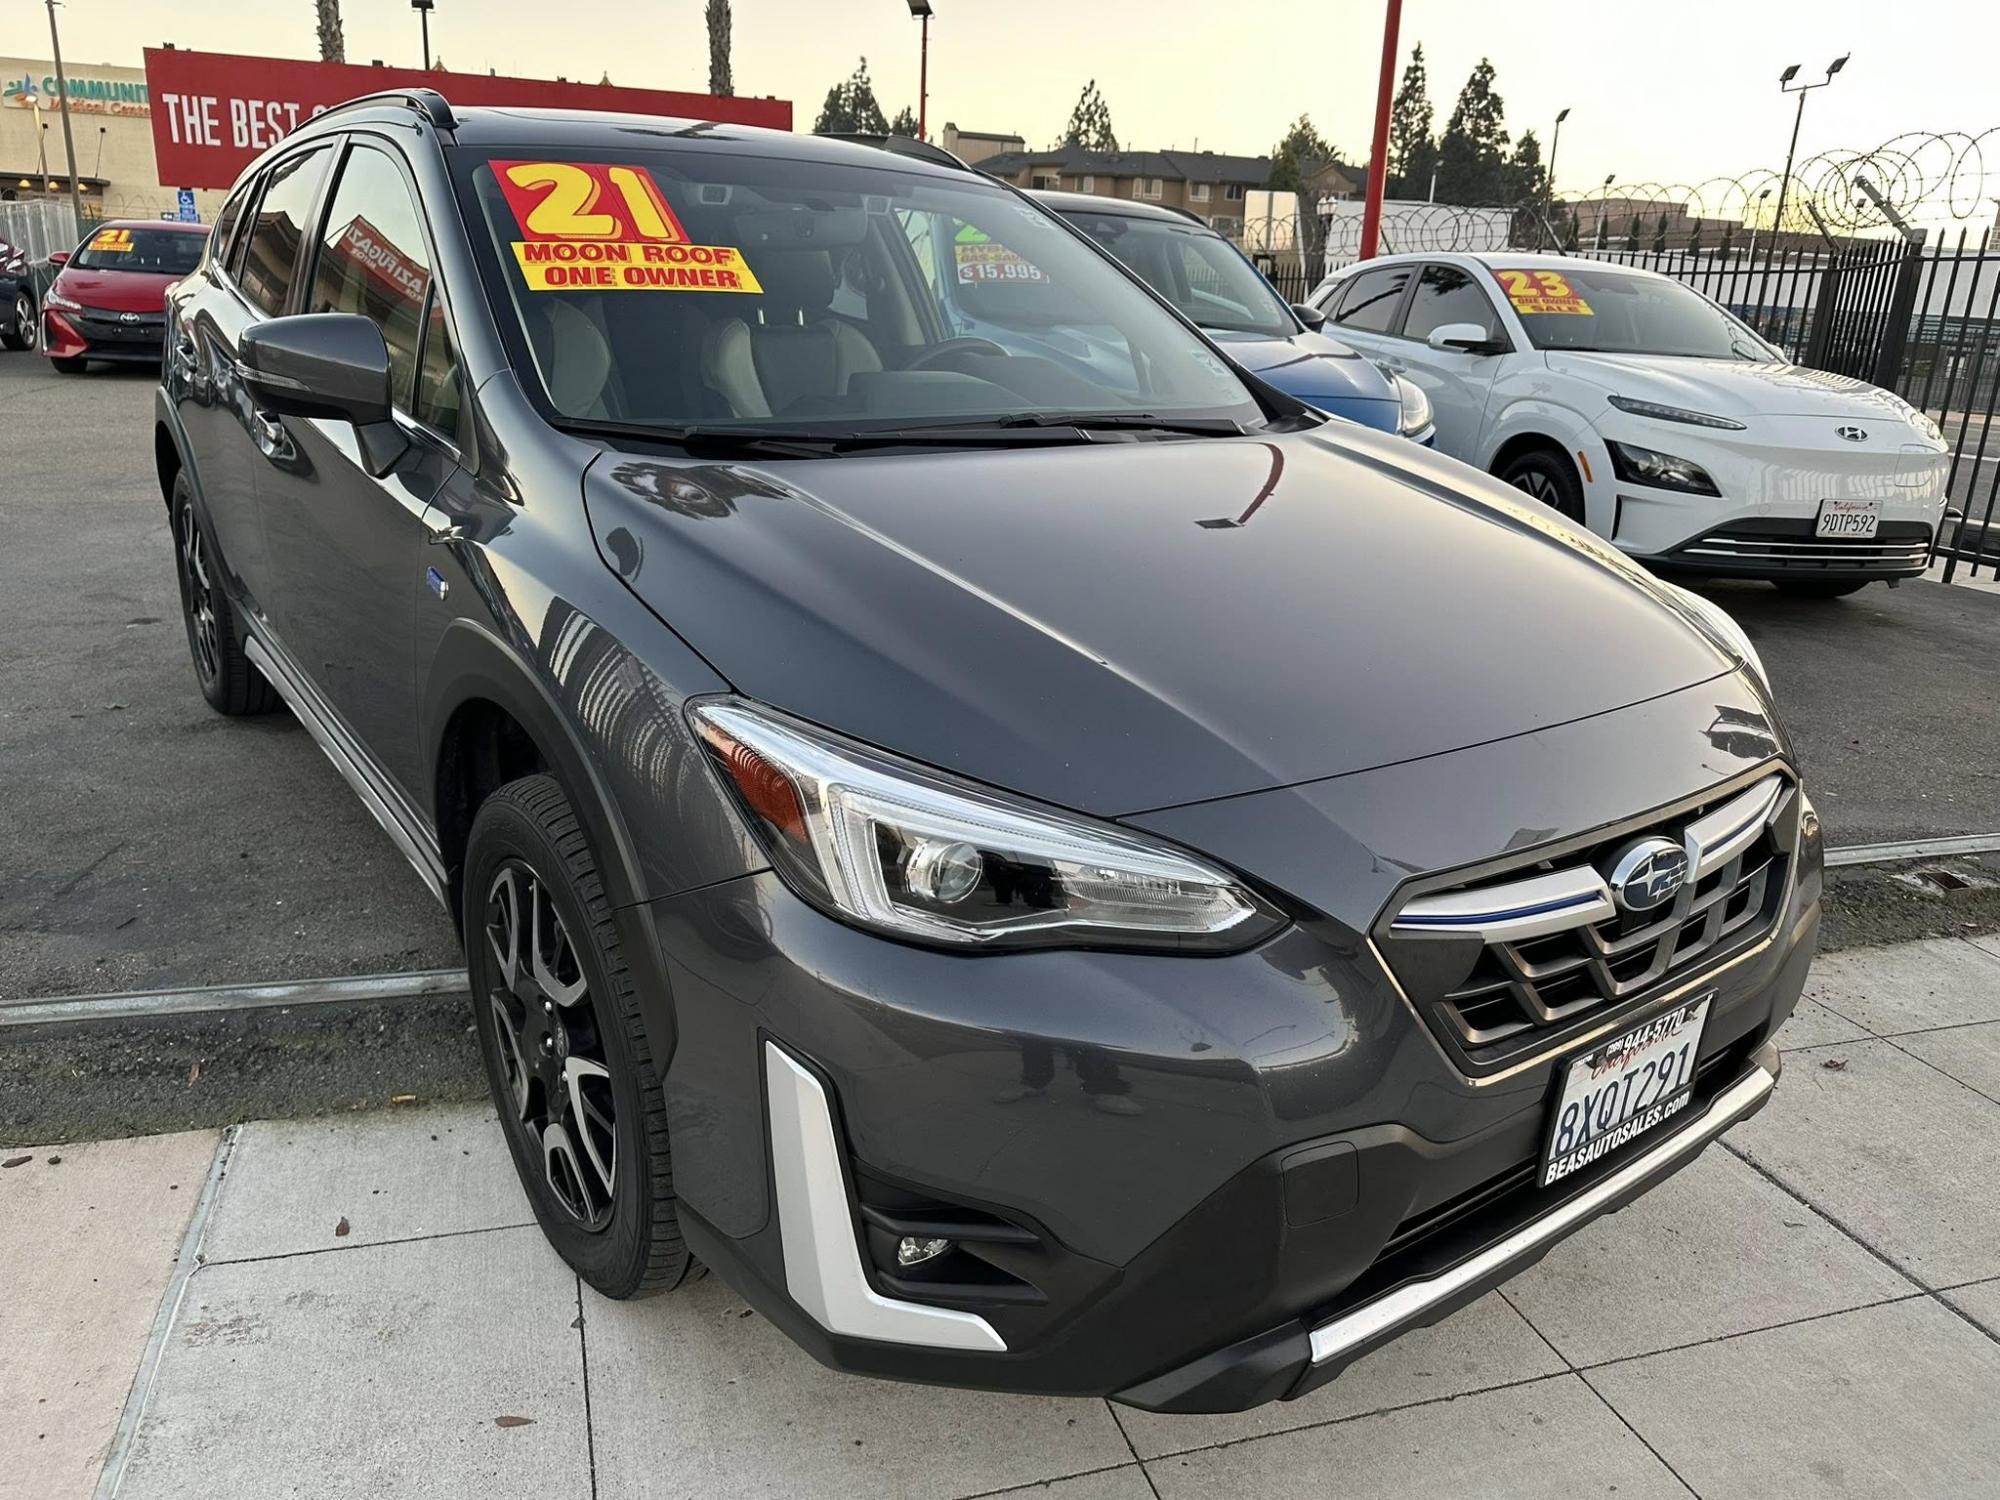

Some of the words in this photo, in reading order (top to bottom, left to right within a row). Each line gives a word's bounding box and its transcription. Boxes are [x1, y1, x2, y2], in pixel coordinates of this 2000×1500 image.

[162, 93, 221, 146] THE
[230, 98, 299, 150] BEST
[506, 163, 679, 241] 21
[97, 229, 131, 242] 21
[524, 243, 630, 263] MOON
[643, 245, 734, 266] ROOF
[544, 266, 616, 287] ONE
[623, 267, 741, 289] OWNER
[962, 263, 1041, 280] $15,995
[1498, 271, 1571, 297] 23
[1531, 304, 1580, 313] SALE
[1821, 513, 1876, 533] 9DTP592
[1623, 1007, 1686, 1054] 944-5770
[1555, 1041, 1691, 1159] 8XQT291
[1544, 1090, 1690, 1186] BEASAUTOSALES.com
